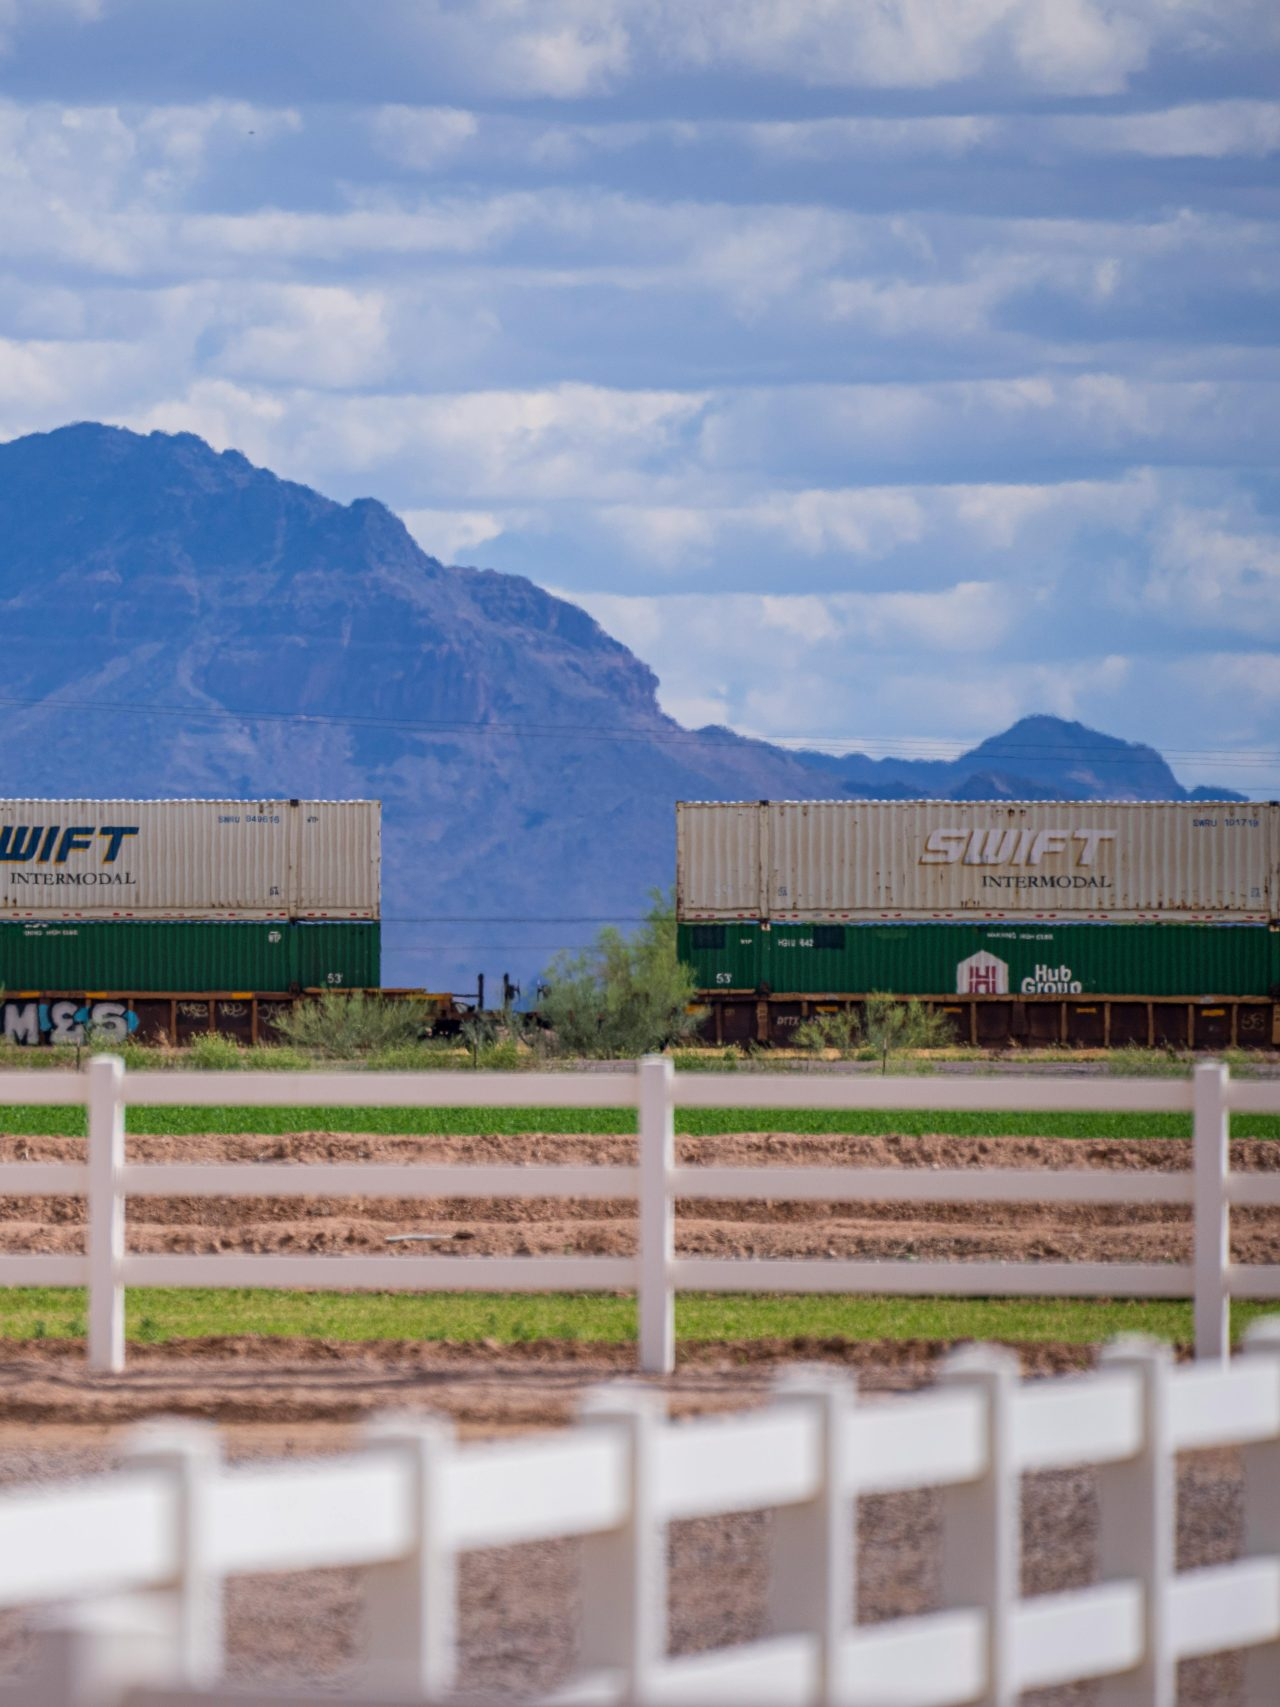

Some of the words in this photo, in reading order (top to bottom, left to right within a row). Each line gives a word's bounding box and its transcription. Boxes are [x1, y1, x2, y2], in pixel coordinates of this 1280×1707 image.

[918, 828, 1117, 866] SWIFT
[11, 872, 136, 886] INTERMODAL
[982, 875, 1112, 889] INTERMODAL
[1035, 964, 1072, 982] Hub
[1021, 977, 1082, 994] Group
